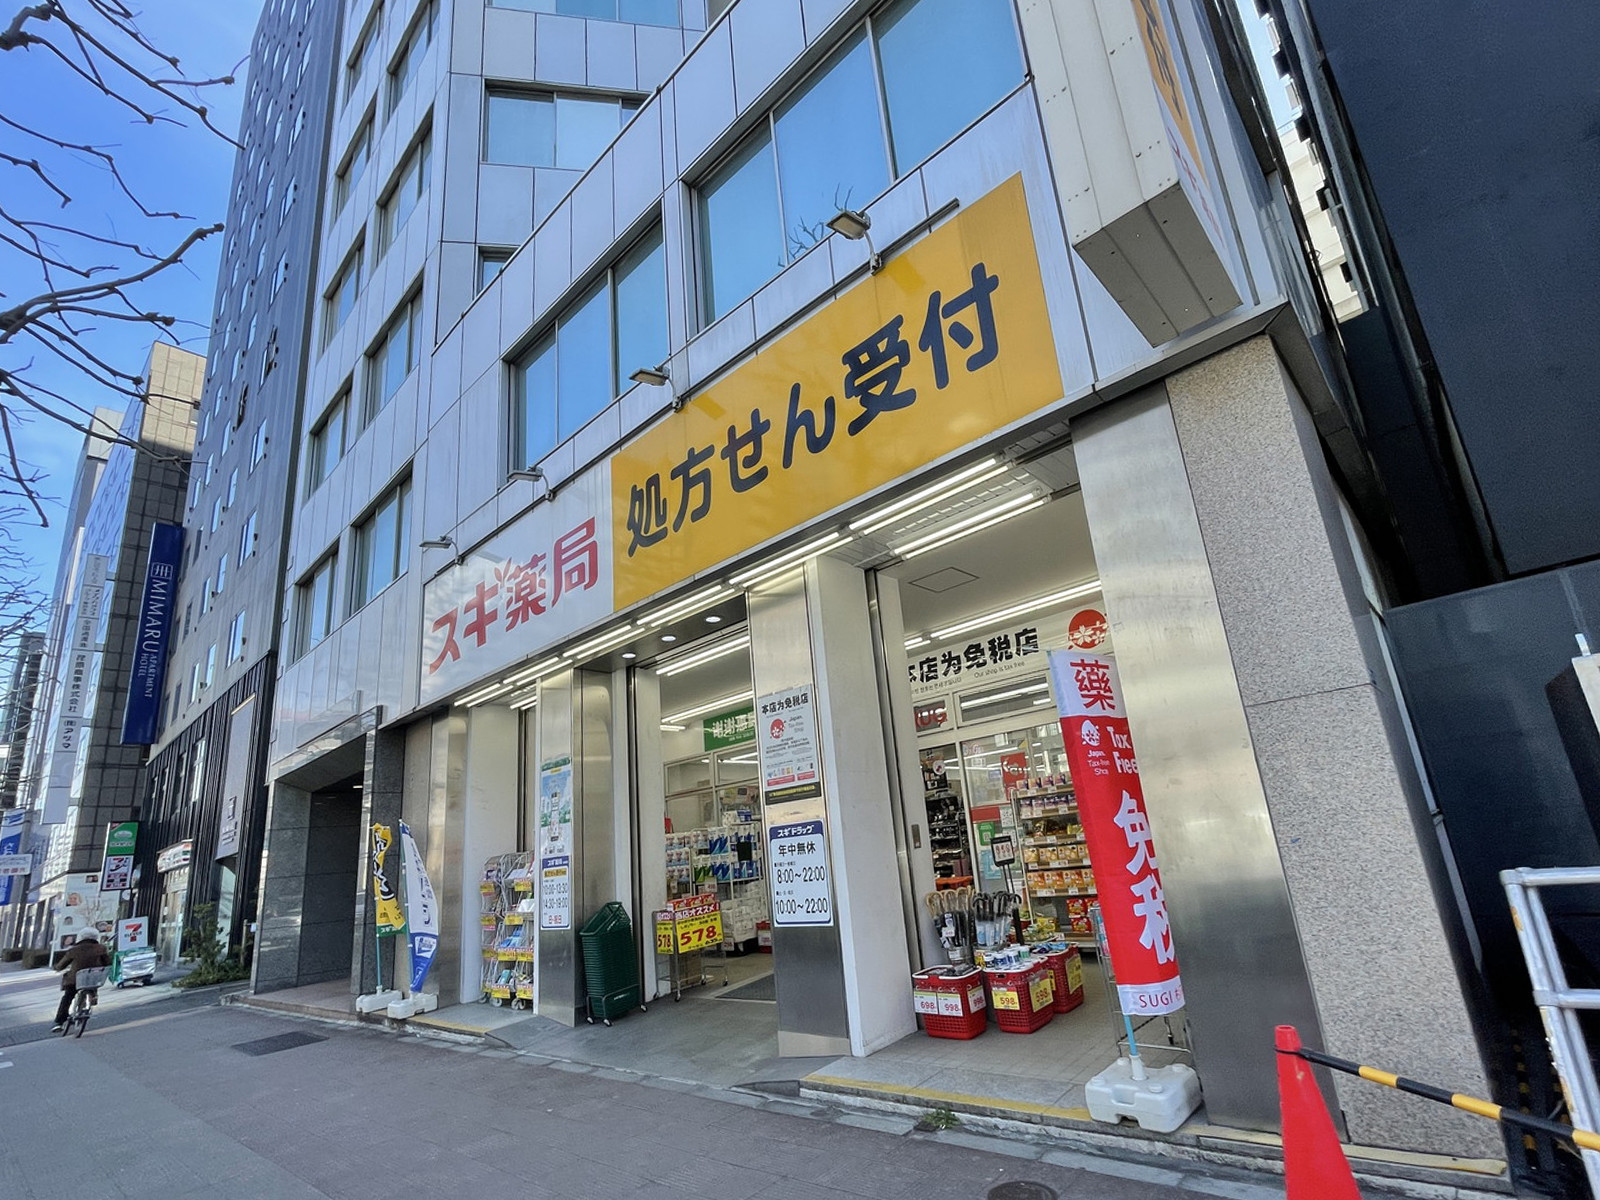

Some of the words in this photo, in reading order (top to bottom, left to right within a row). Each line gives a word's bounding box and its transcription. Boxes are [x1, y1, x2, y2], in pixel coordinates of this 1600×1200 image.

[627, 262, 1000, 557] 処方せん受付
[429, 516, 599, 675] スギ薬局
[142, 579, 168, 653] MIMARU
[138, 653, 149, 677] HOTEL
[145, 653, 158, 698] APARTMENT
[1070, 659, 1116, 711] 藥
[1106, 726, 1132, 749] Tax
[1112, 751, 1138, 774] Free
[777, 825, 815, 838] スギドラッグ
[778, 841, 816, 857] 年中無休
[777, 866, 826, 884] 8:00~22:00
[776, 898, 828, 915] 10:00~22:00
[657, 934, 671, 948] 578
[680, 925, 717, 947] 578
[1139, 990, 1173, 1008] SUGI
